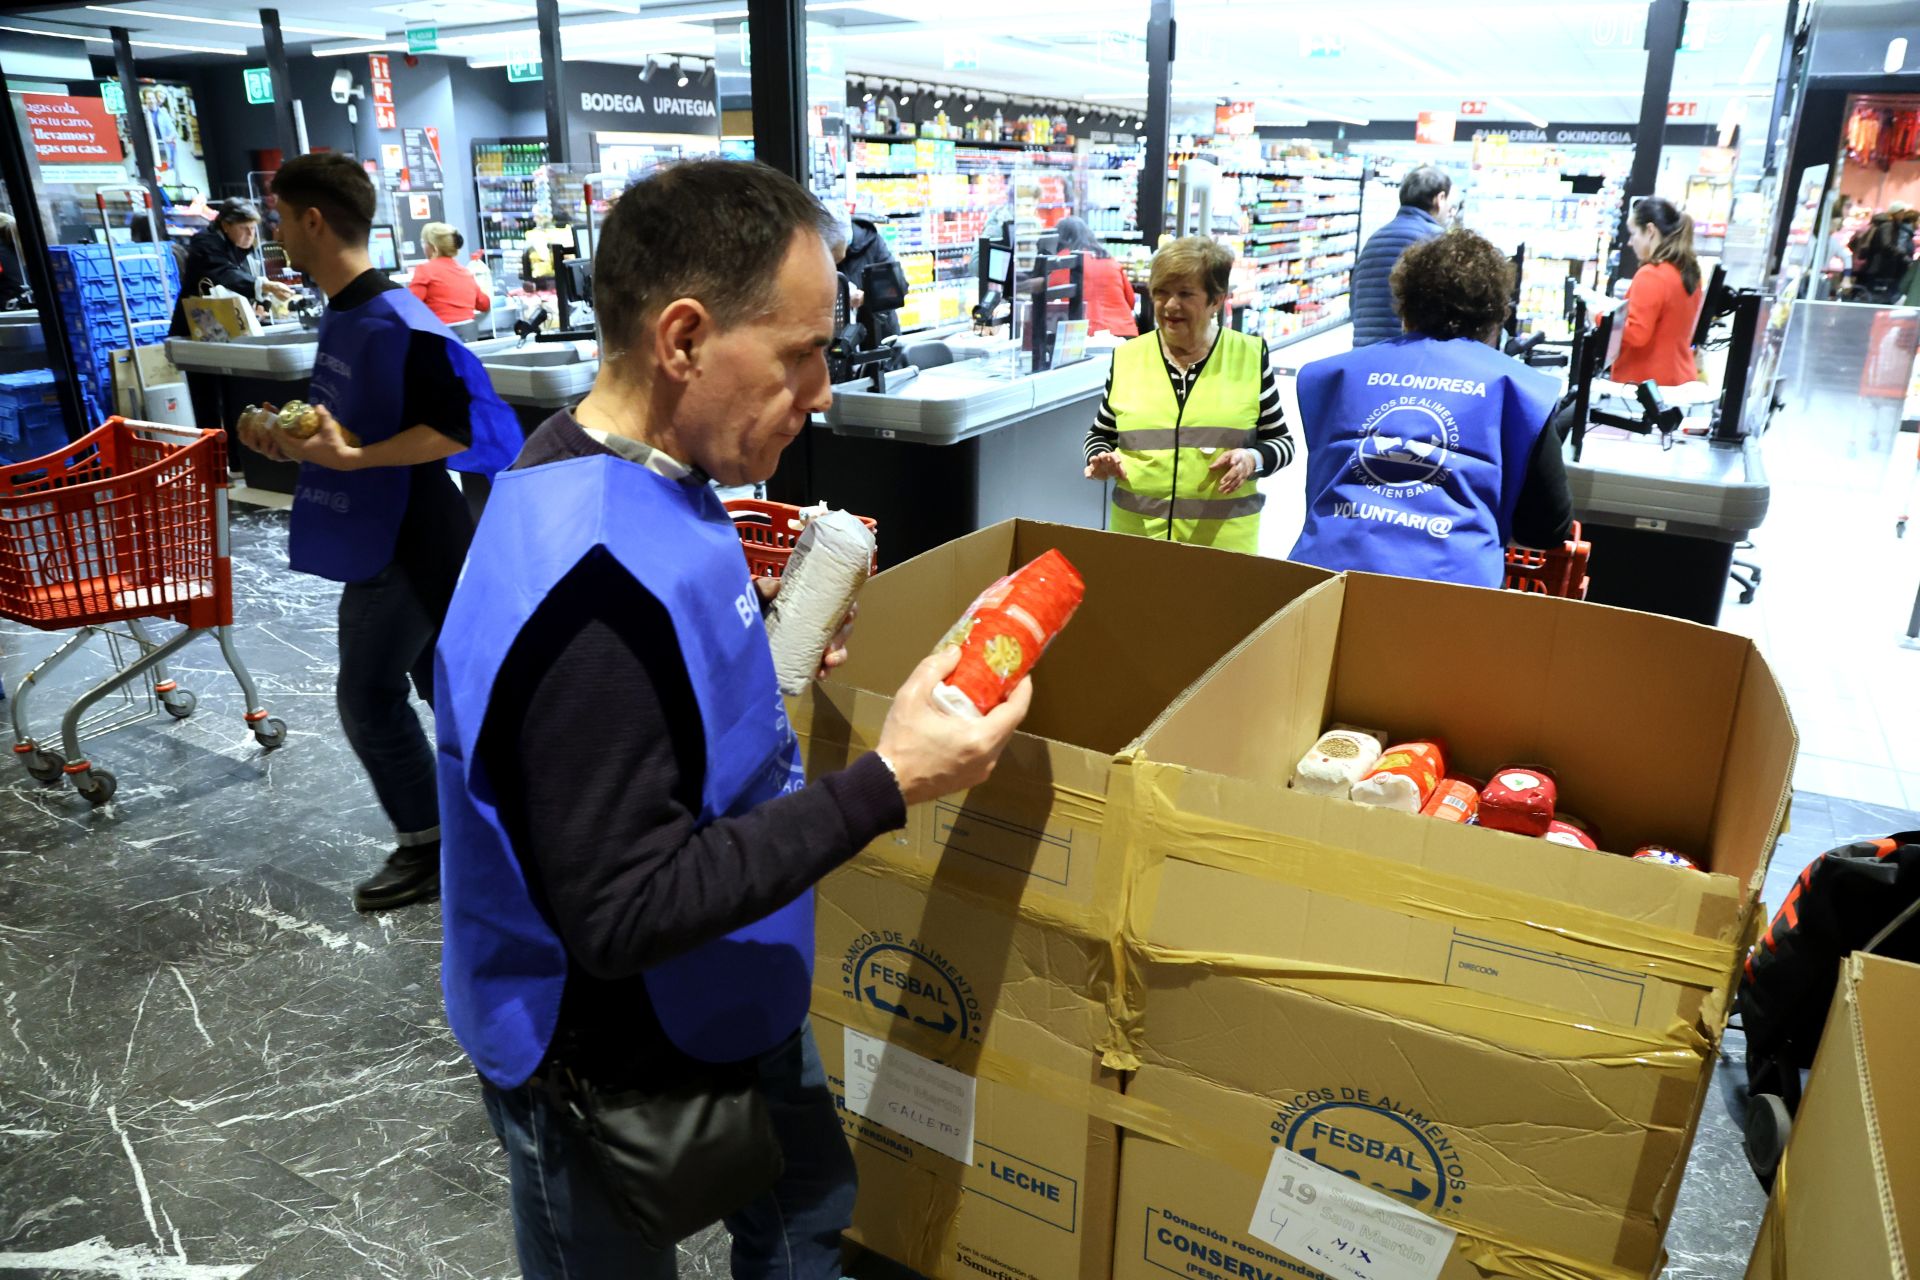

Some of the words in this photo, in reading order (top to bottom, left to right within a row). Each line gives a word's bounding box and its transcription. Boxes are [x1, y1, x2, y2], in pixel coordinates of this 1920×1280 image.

[580, 93, 645, 113] BODEGA
[653, 96, 717, 117] UPATEGIA
[33, 128, 87, 140] llevamos
[88, 132, 96, 144] y
[1556, 129, 1632, 143] OKINDEGIA
[1367, 372, 1487, 398] BOLONDRESA
[1399, 396, 1417, 405] DE
[1417, 397, 1460, 451] ALIMENTOS
[1333, 502, 1453, 539] VOLUNTARI@
[842, 930, 882, 975] BANCOS
[883, 929, 904, 945] DE
[909, 939, 982, 1022] ALIMENTOS
[870, 962, 949, 1006] FESBAL
[854, 1048, 880, 1074] 19
[1271, 1090, 1335, 1134] BANCOS
[1340, 1087, 1370, 1102] DE
[1377, 1096, 1467, 1191] ALIMENTOS
[1312, 1121, 1423, 1173] FESBAL
[990, 1161, 1060, 1203] LECHE
[1277, 1174, 1317, 1206] 19
[1162, 1208, 1229, 1245] Donación
[1330, 1237, 1372, 1264] MIX
